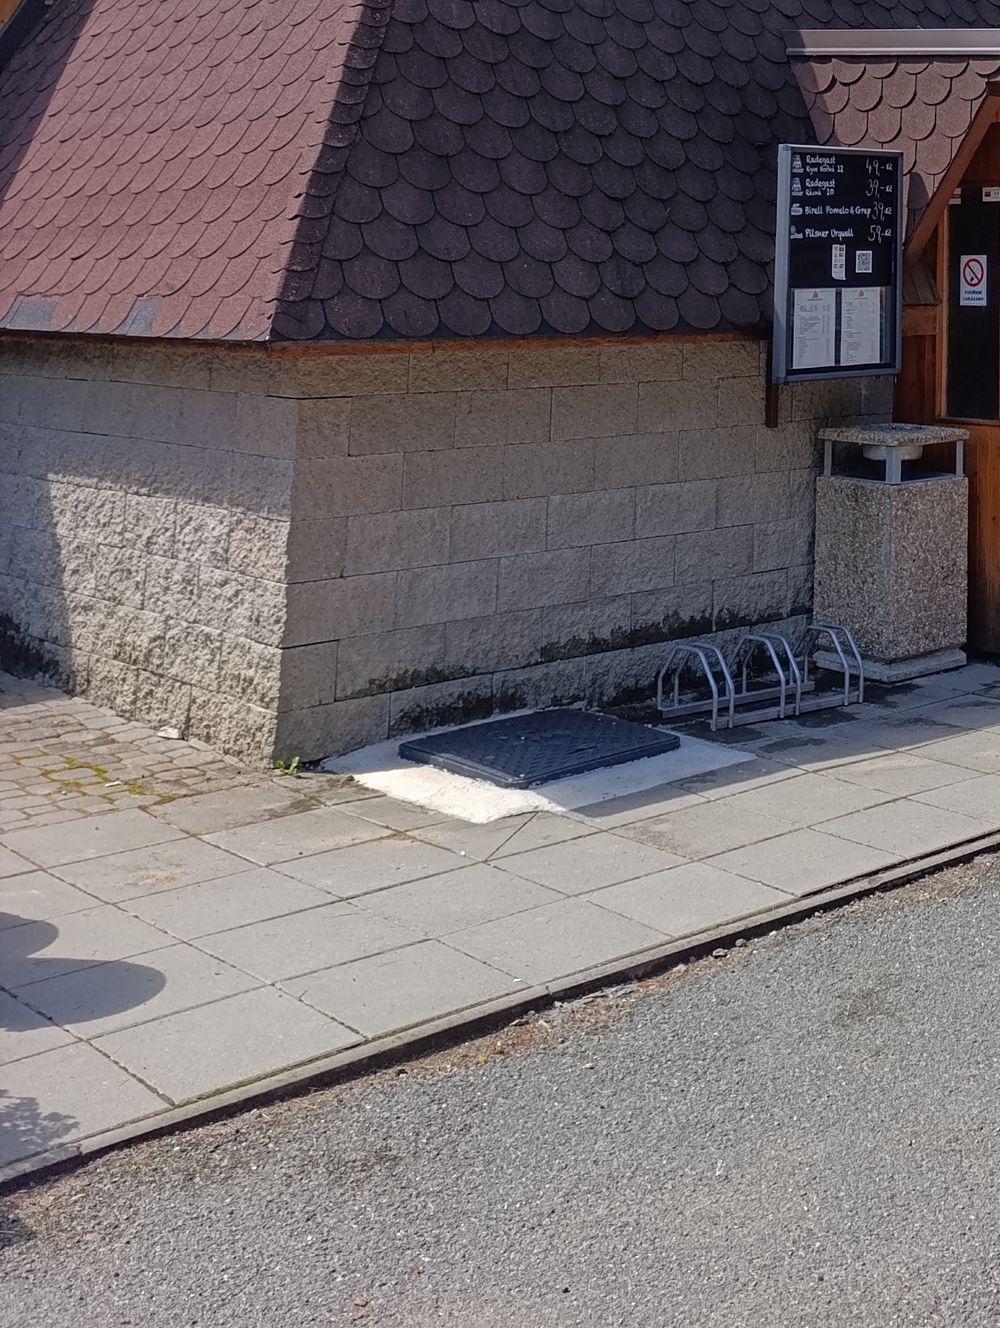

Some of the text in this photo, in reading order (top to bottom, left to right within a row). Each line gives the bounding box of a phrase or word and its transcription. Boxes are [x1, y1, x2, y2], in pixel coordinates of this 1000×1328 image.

[806, 155, 836, 166] Radegast
[837, 164, 844, 173] 12
[806, 178, 836, 190] Radegast
[826, 187, 835, 196] 10
[805, 205, 871, 219] Birell Pomelo & Grep
[805, 228, 854, 241] Pilsner Urquell
